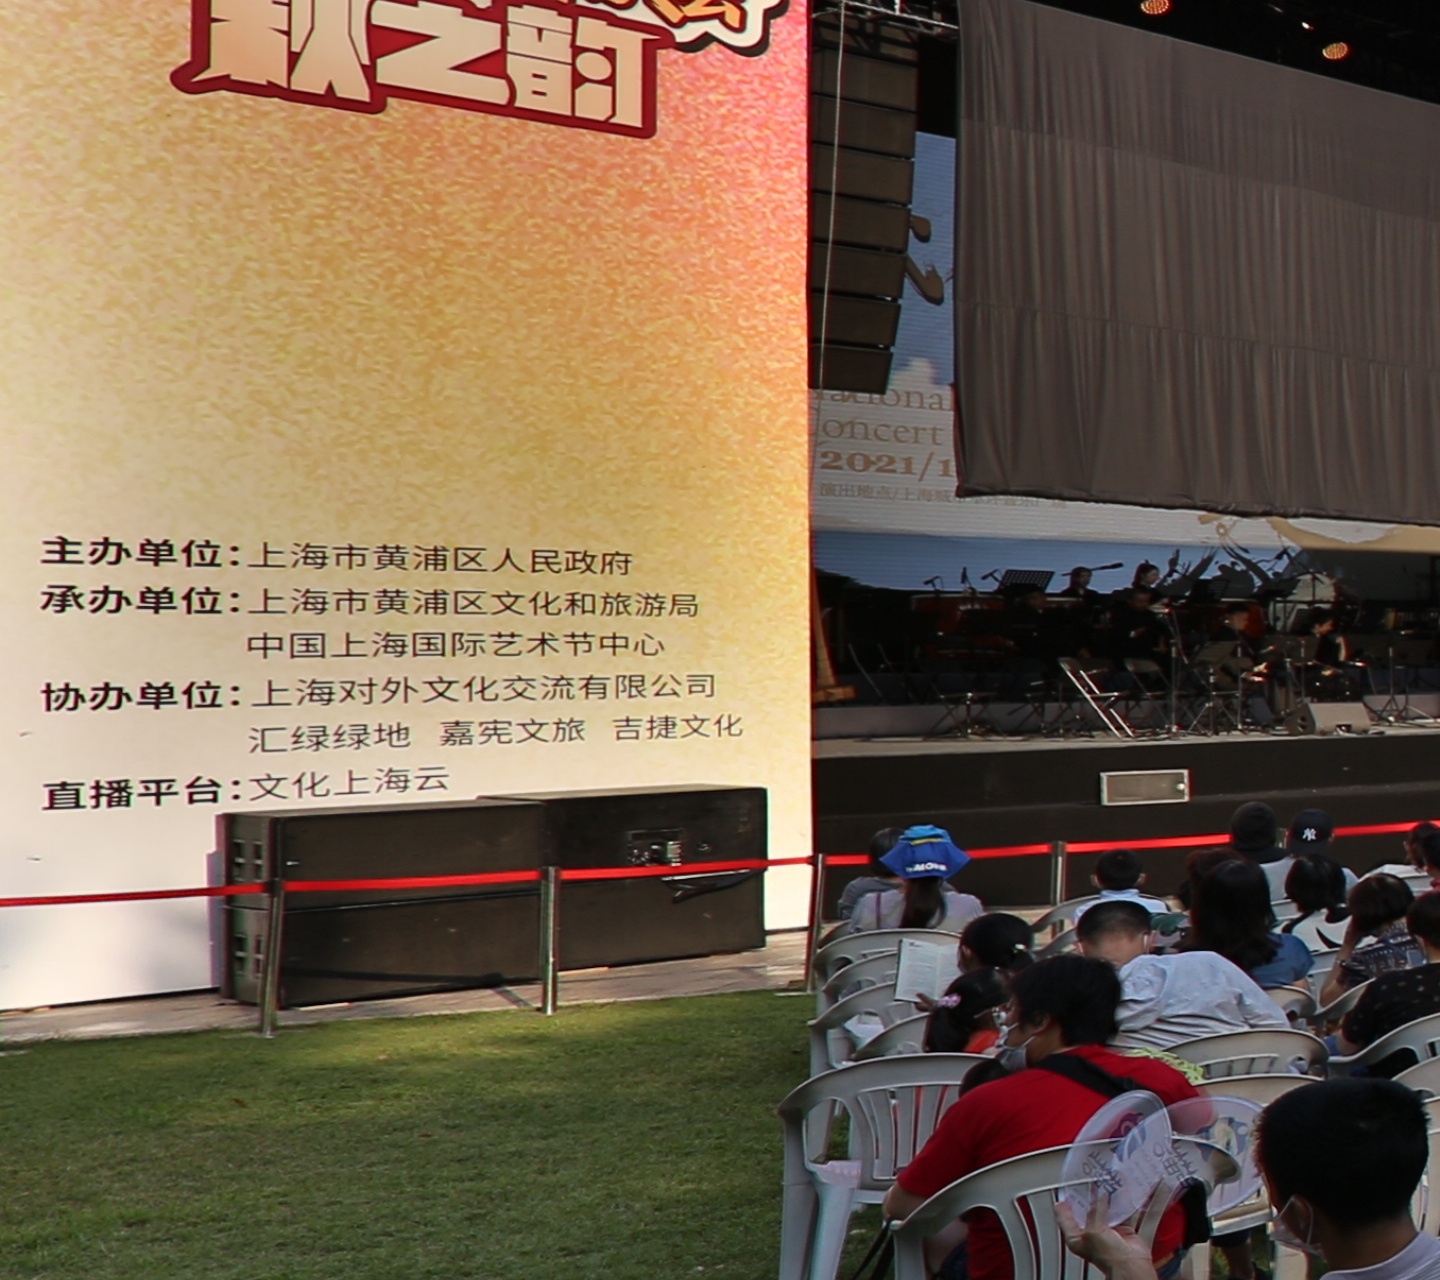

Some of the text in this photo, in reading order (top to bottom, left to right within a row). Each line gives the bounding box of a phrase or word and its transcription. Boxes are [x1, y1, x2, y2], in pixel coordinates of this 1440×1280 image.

[246, 630, 667, 660] 中国上海国际艺术节中心
[247, 712, 744, 754] 汇绿绿地 嘉宪文旅 吉捷文化
